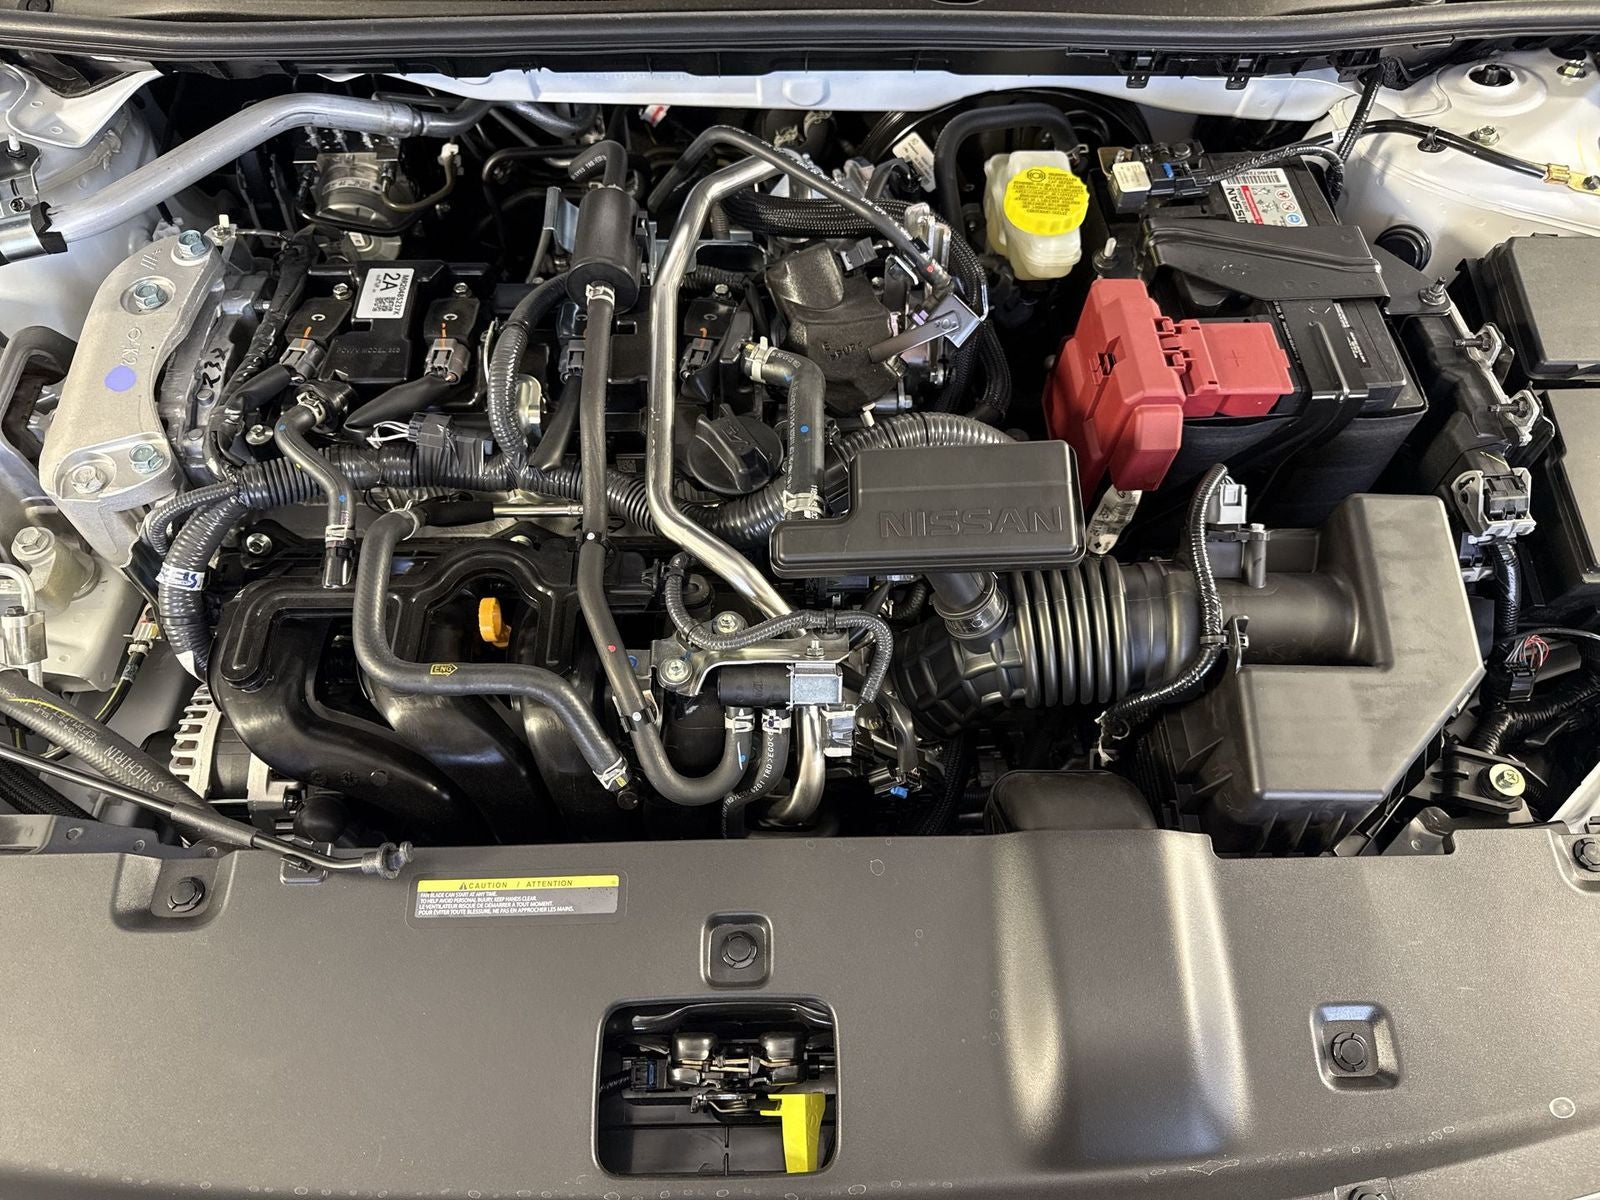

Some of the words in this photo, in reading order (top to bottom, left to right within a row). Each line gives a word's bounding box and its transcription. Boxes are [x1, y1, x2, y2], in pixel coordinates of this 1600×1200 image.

[380, 272, 401, 291] 2A
[879, 506, 1063, 538] NISSAN
[434, 665, 453, 673] ENG
[526, 879, 573, 887] ATTENTION
